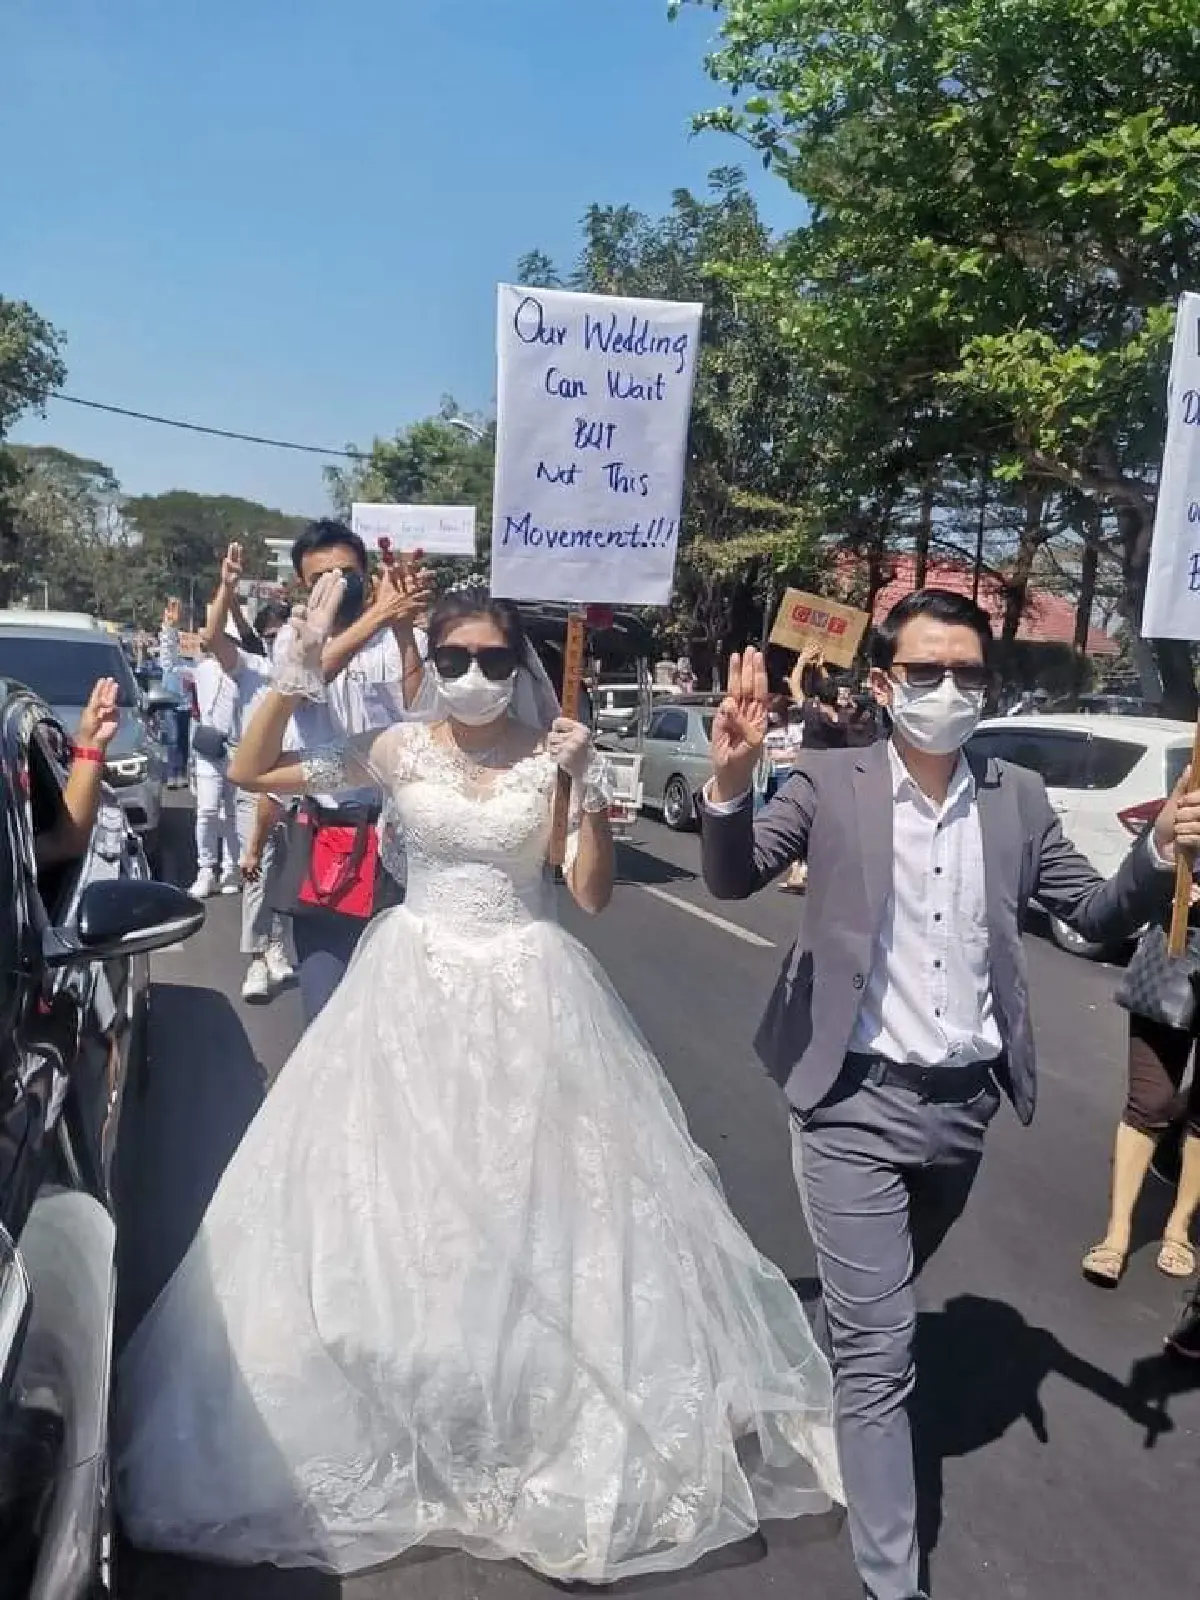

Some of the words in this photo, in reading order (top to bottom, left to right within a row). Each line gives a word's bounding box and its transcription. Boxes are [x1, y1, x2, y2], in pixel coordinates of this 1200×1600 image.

[514, 296, 568, 345] Our
[584, 312, 689, 374] Wedding
[546, 366, 588, 398] Can
[607, 369, 666, 401] Wait
[574, 416, 618, 450] BUT
[536, 461, 583, 485] Not
[601, 461, 649, 497] This
[502, 512, 678, 548] Movement!!!
